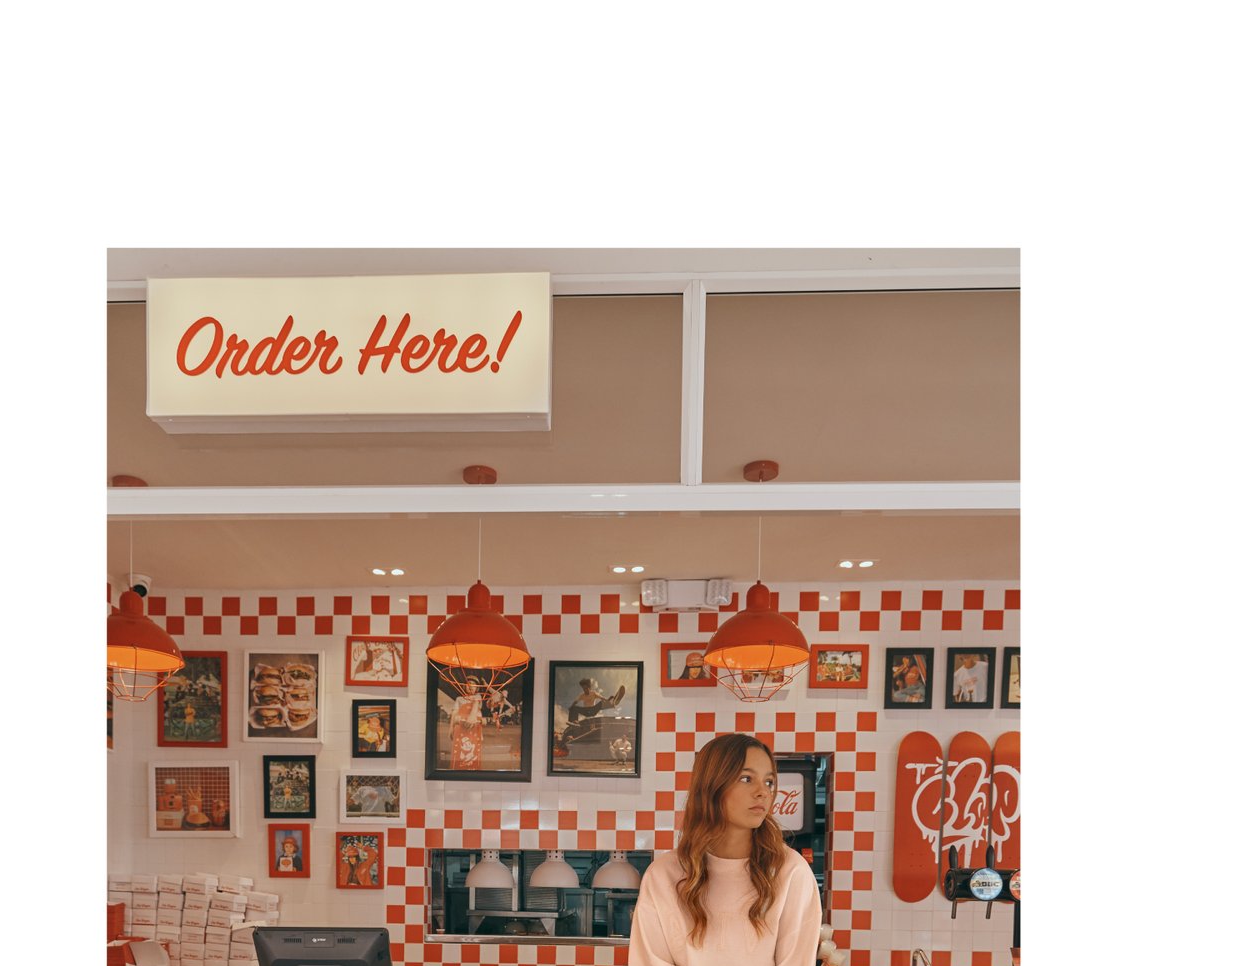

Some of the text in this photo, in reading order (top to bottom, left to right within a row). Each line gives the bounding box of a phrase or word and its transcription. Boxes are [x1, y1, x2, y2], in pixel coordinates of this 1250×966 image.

[176, 310, 523, 378] Order Here!
[771, 789, 802, 815] ola
